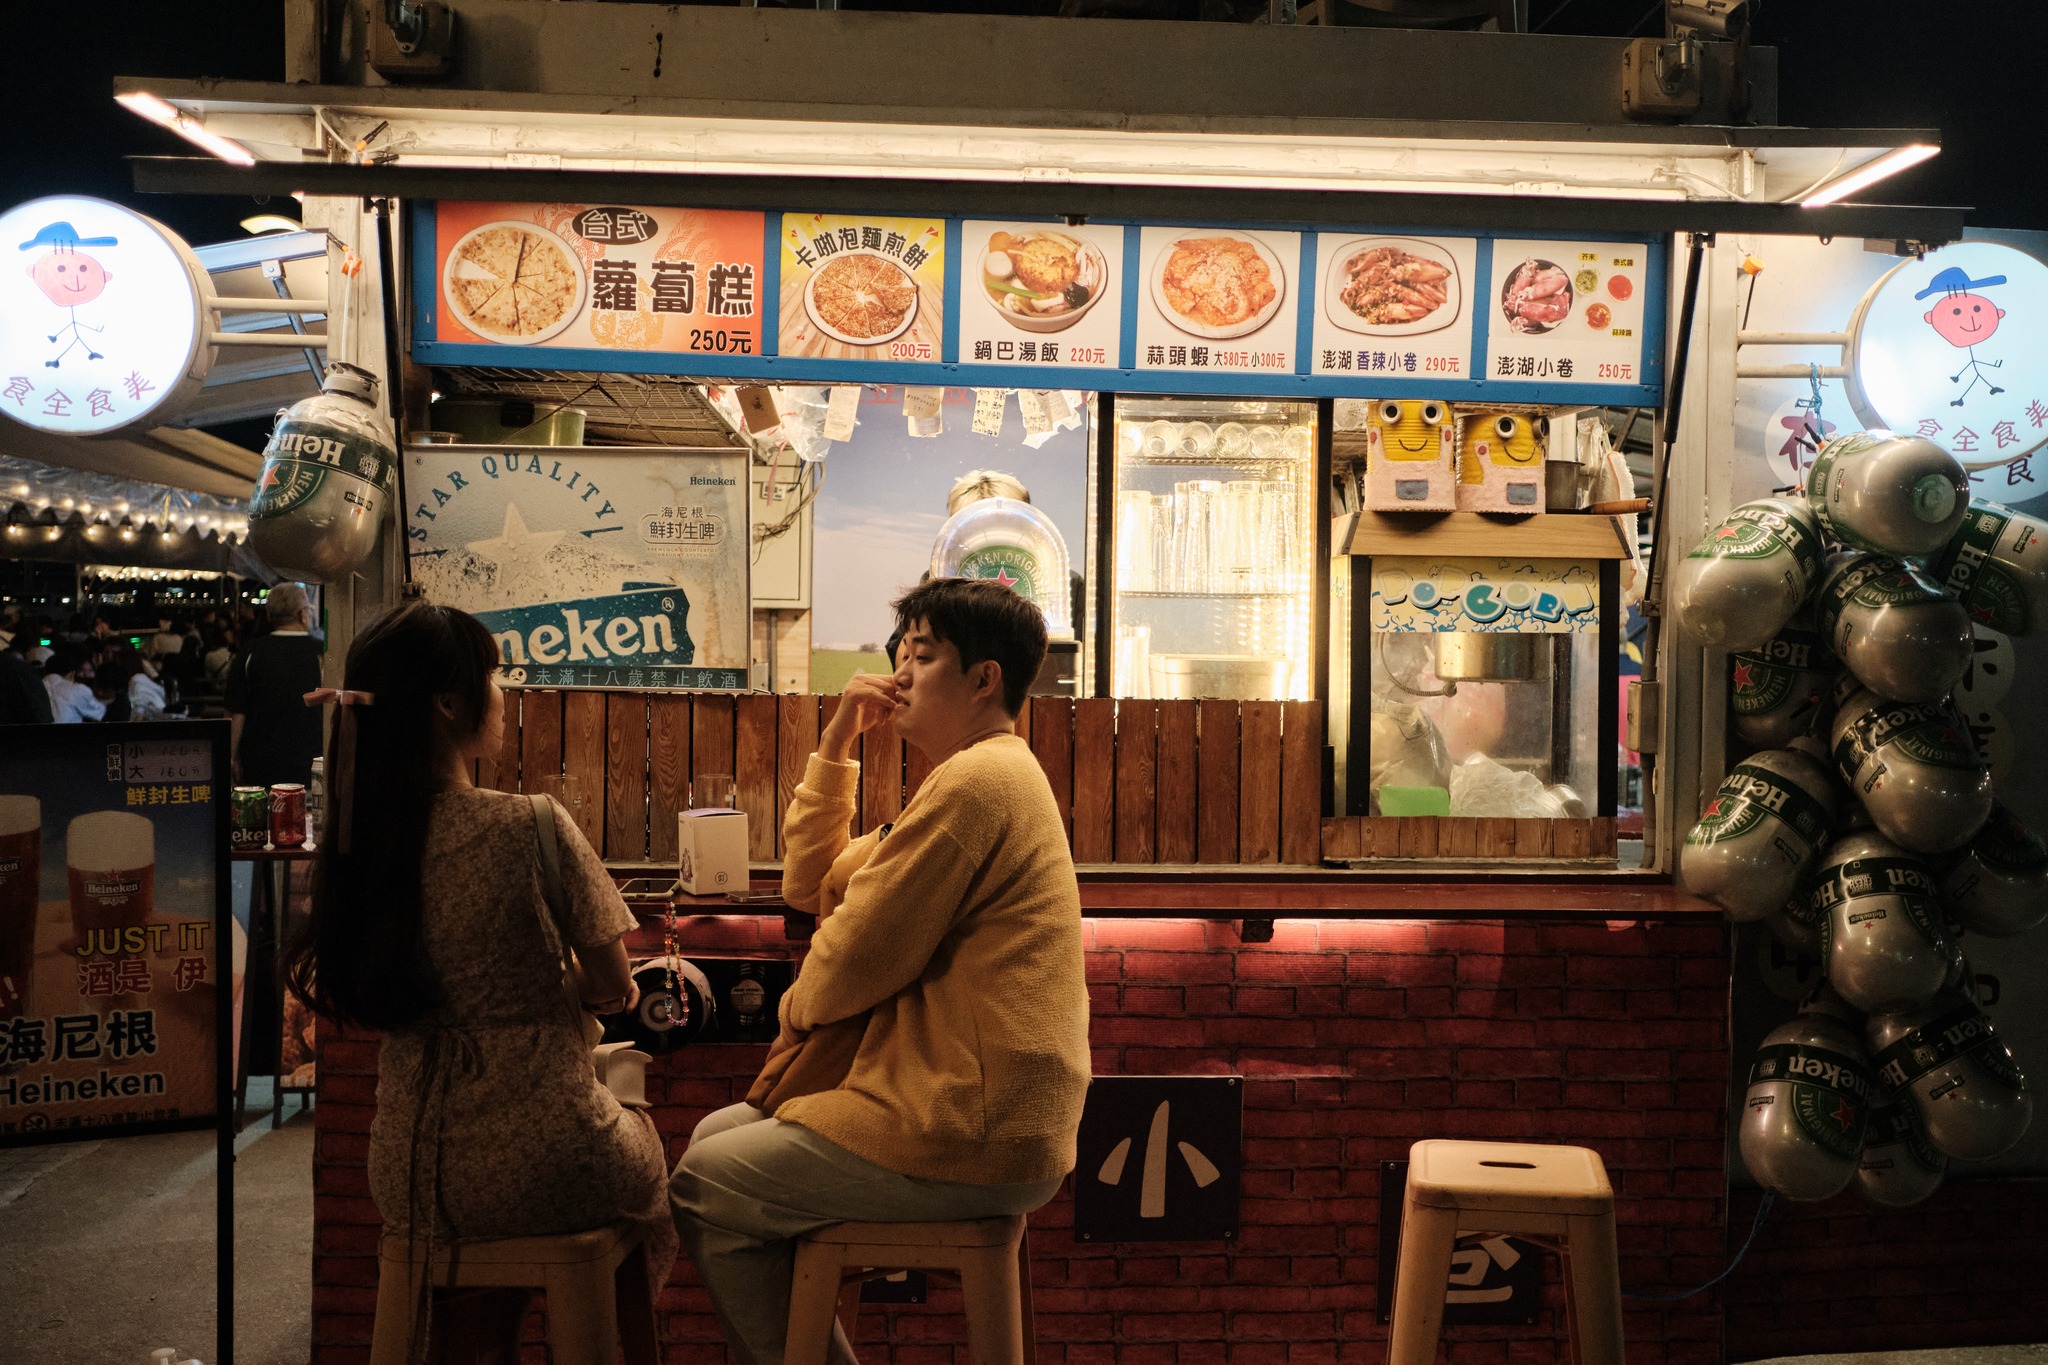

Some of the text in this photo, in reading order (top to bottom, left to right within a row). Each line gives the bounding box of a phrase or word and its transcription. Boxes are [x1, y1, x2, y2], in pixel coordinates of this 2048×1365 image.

[581, 209, 651, 242] 台式
[795, 226, 929, 271] 卡啪泡麵煎餅
[592, 259, 755, 318] 蘿蔔糕
[690, 329, 753, 355] 250元
[892, 343, 932, 359] 200元
[974, 340, 1106, 364] 鍋巴湯飯 220元
[1147, 345, 1209, 366] 蒜頭蝦
[1425, 356, 1459, 373] 290元
[1497, 356, 1632, 380] 澎湖小卷 250元
[690, 476, 736, 486] Heineken
[409, 452, 616, 542] STAR QUALITY
[661, 506, 704, 519] 海尼根
[650, 521, 715, 540] 鮮封生啤
[536, 668, 737, 689] 未滿十八歲禁止飲酒
[127, 785, 212, 806] 鮮封生啤
[88, 881, 139, 894] Heineken
[76, 922, 210, 957] JUST IT
[79, 956, 208, 996] 酒是 伊
[0, 1010, 156, 1063] 海尼根
[1096, 1099, 1221, 1219] 小
